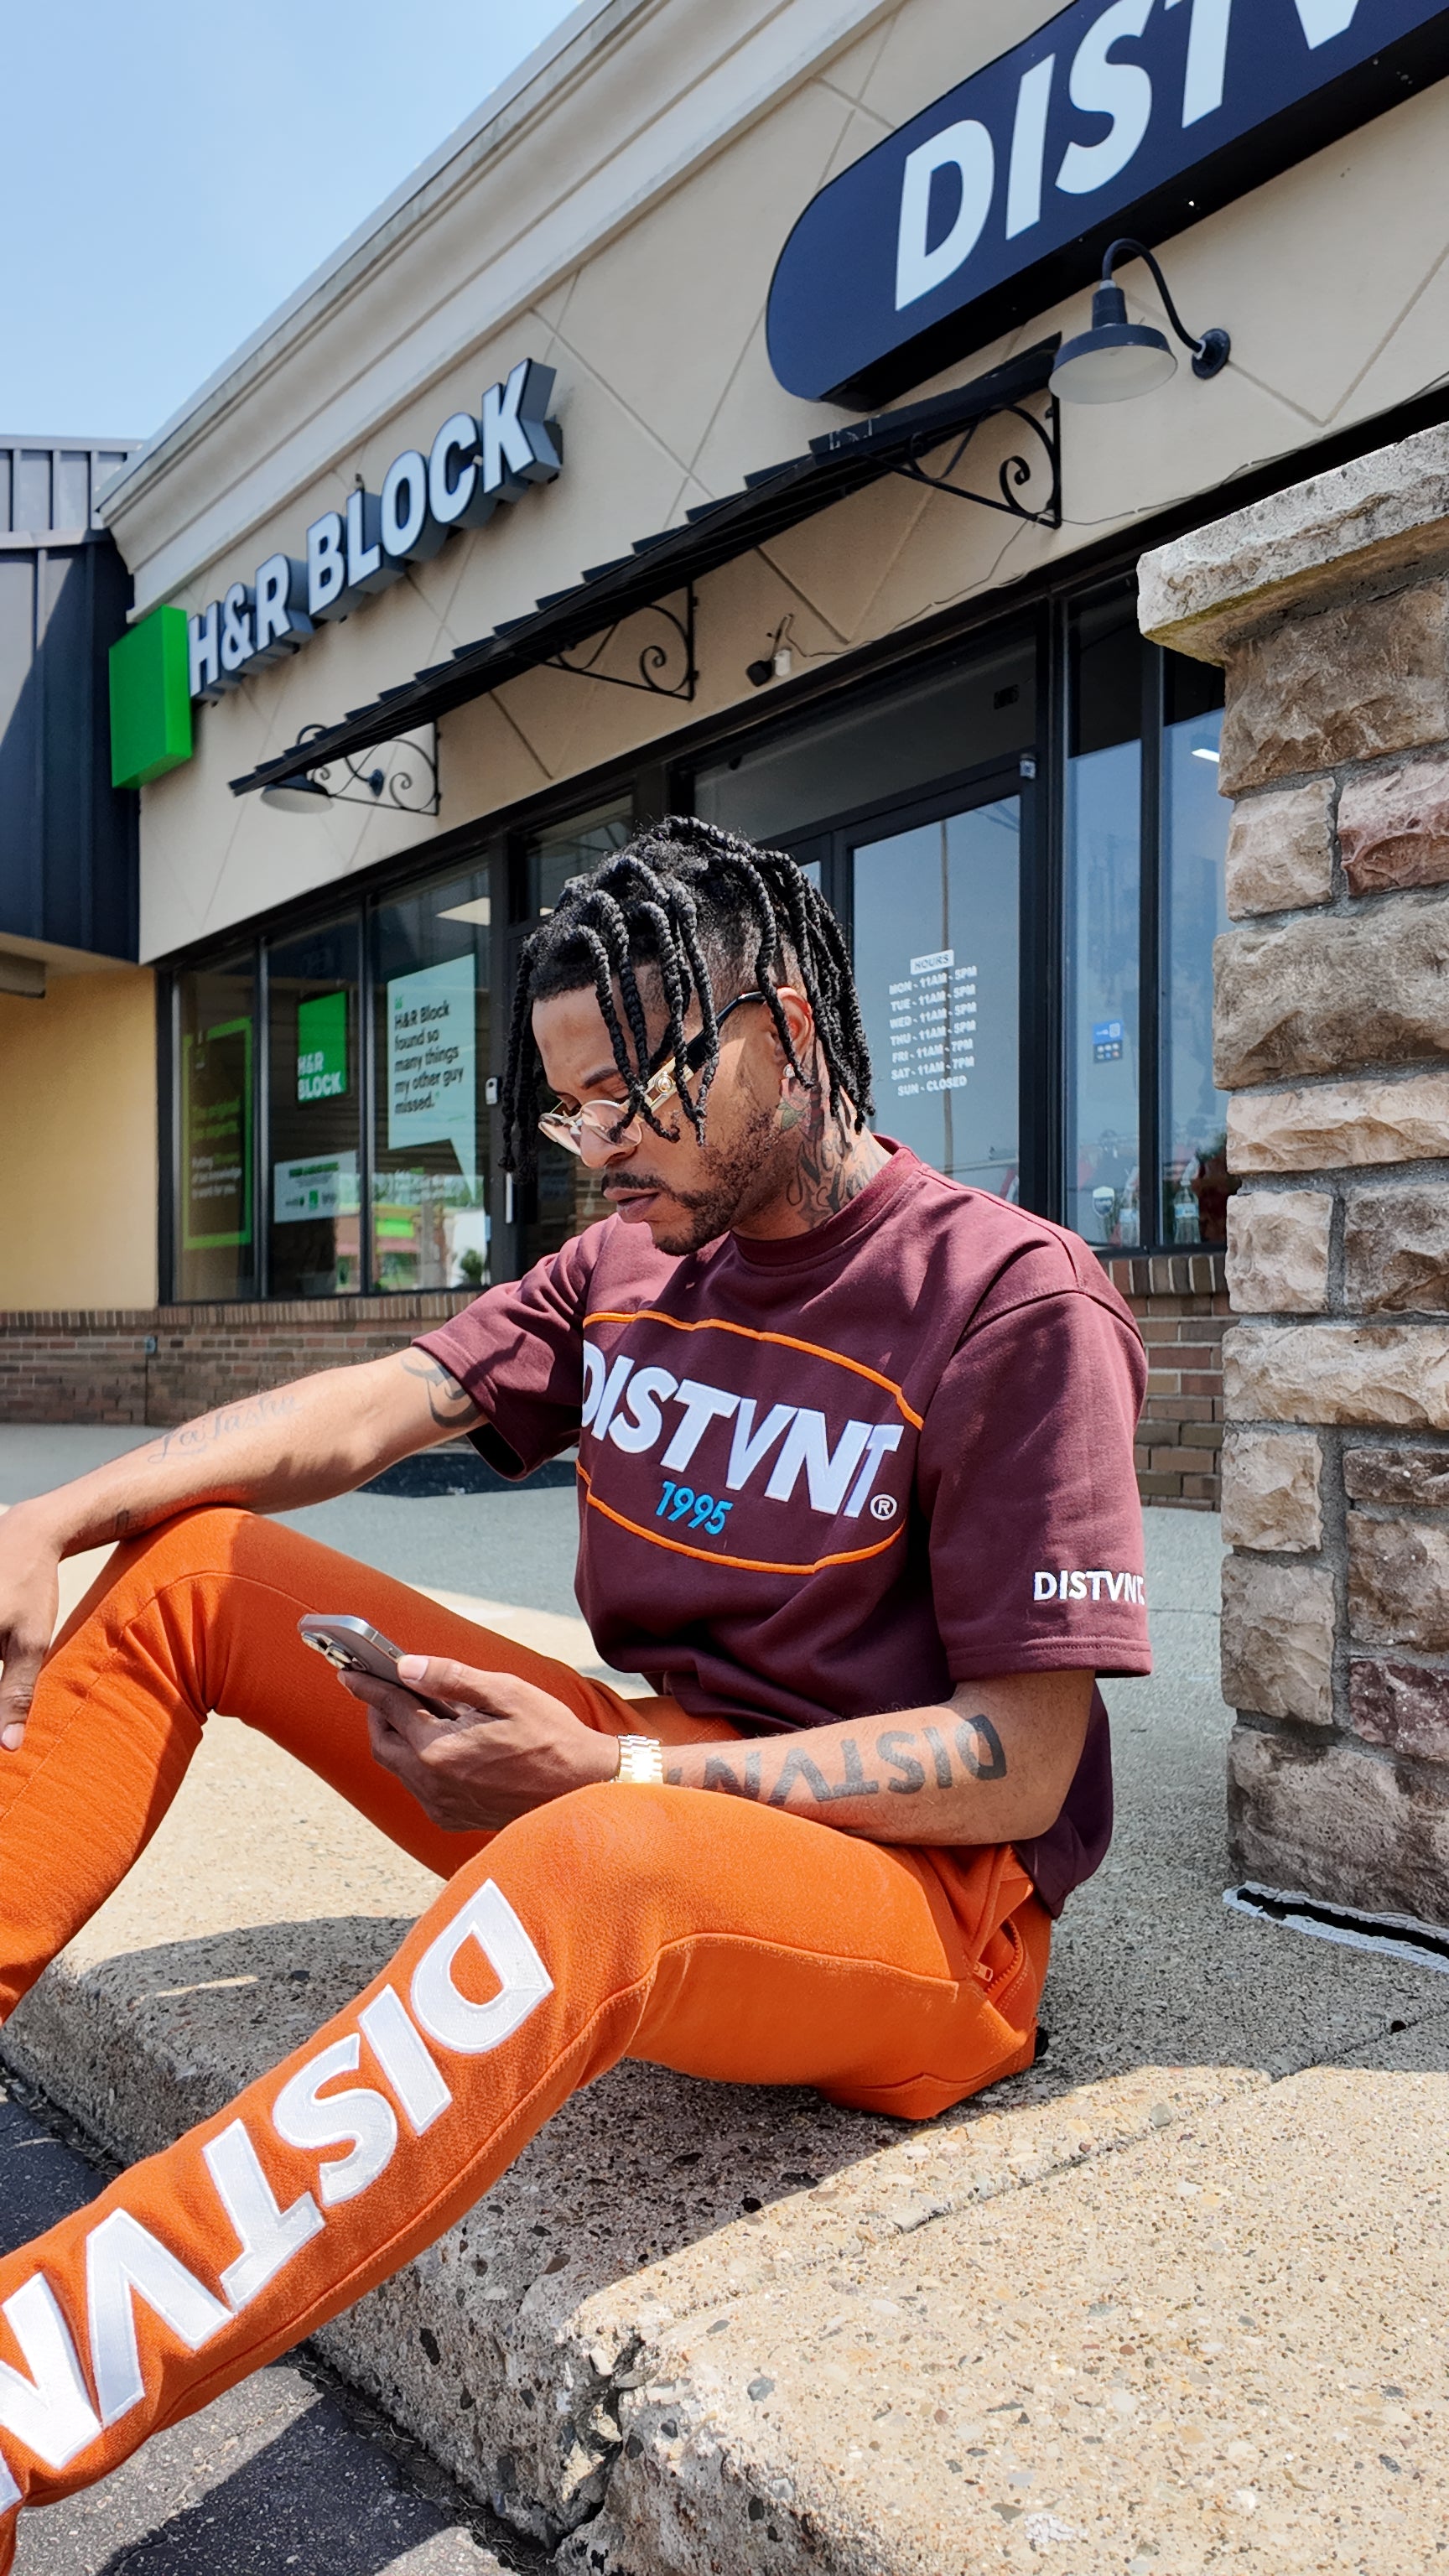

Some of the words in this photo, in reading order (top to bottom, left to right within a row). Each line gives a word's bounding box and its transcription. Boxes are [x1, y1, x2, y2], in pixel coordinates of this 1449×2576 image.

[189, 553, 293, 698] H&R
[306, 358, 538, 616] BLOCK
[914, 954, 949, 970] HOURS
[889, 981, 912, 995] MON
[920, 973, 948, 988] 11AM
[955, 965, 977, 980] 5PM
[891, 998, 911, 1011] TUE
[918, 990, 946, 1005] 11AM
[953, 984, 976, 999] 5PM
[395, 1010, 417, 1030] H&R
[420, 1000, 449, 1023] Block
[890, 1015, 912, 1029] WED
[920, 1007, 948, 1023] 11AM
[955, 1001, 977, 1016] 5PM
[395, 1027, 424, 1052] found
[427, 1029, 439, 1043] so
[890, 1033, 911, 1046] THU
[919, 1026, 947, 1040] 11AM
[954, 1020, 976, 1034] 5PM
[298, 1051, 324, 1077] H&R
[395, 1056, 423, 1073] many
[425, 1045, 459, 1064] things
[892, 1051, 909, 1063] FRI
[917, 1044, 943, 1058] 11AM
[951, 1038, 973, 1052] 7PM
[891, 1067, 910, 1080] SAT
[917, 1061, 945, 1076] 11AM
[953, 1056, 974, 1069] 7PM
[298, 1071, 341, 1101] BLOCK
[395, 1079, 410, 1100] my
[413, 1071, 440, 1089] other
[444, 1067, 464, 1087] guy
[897, 1083, 919, 1096] SUN
[927, 1075, 967, 1092] CLOSED
[655, 1481, 733, 1535] 1995
